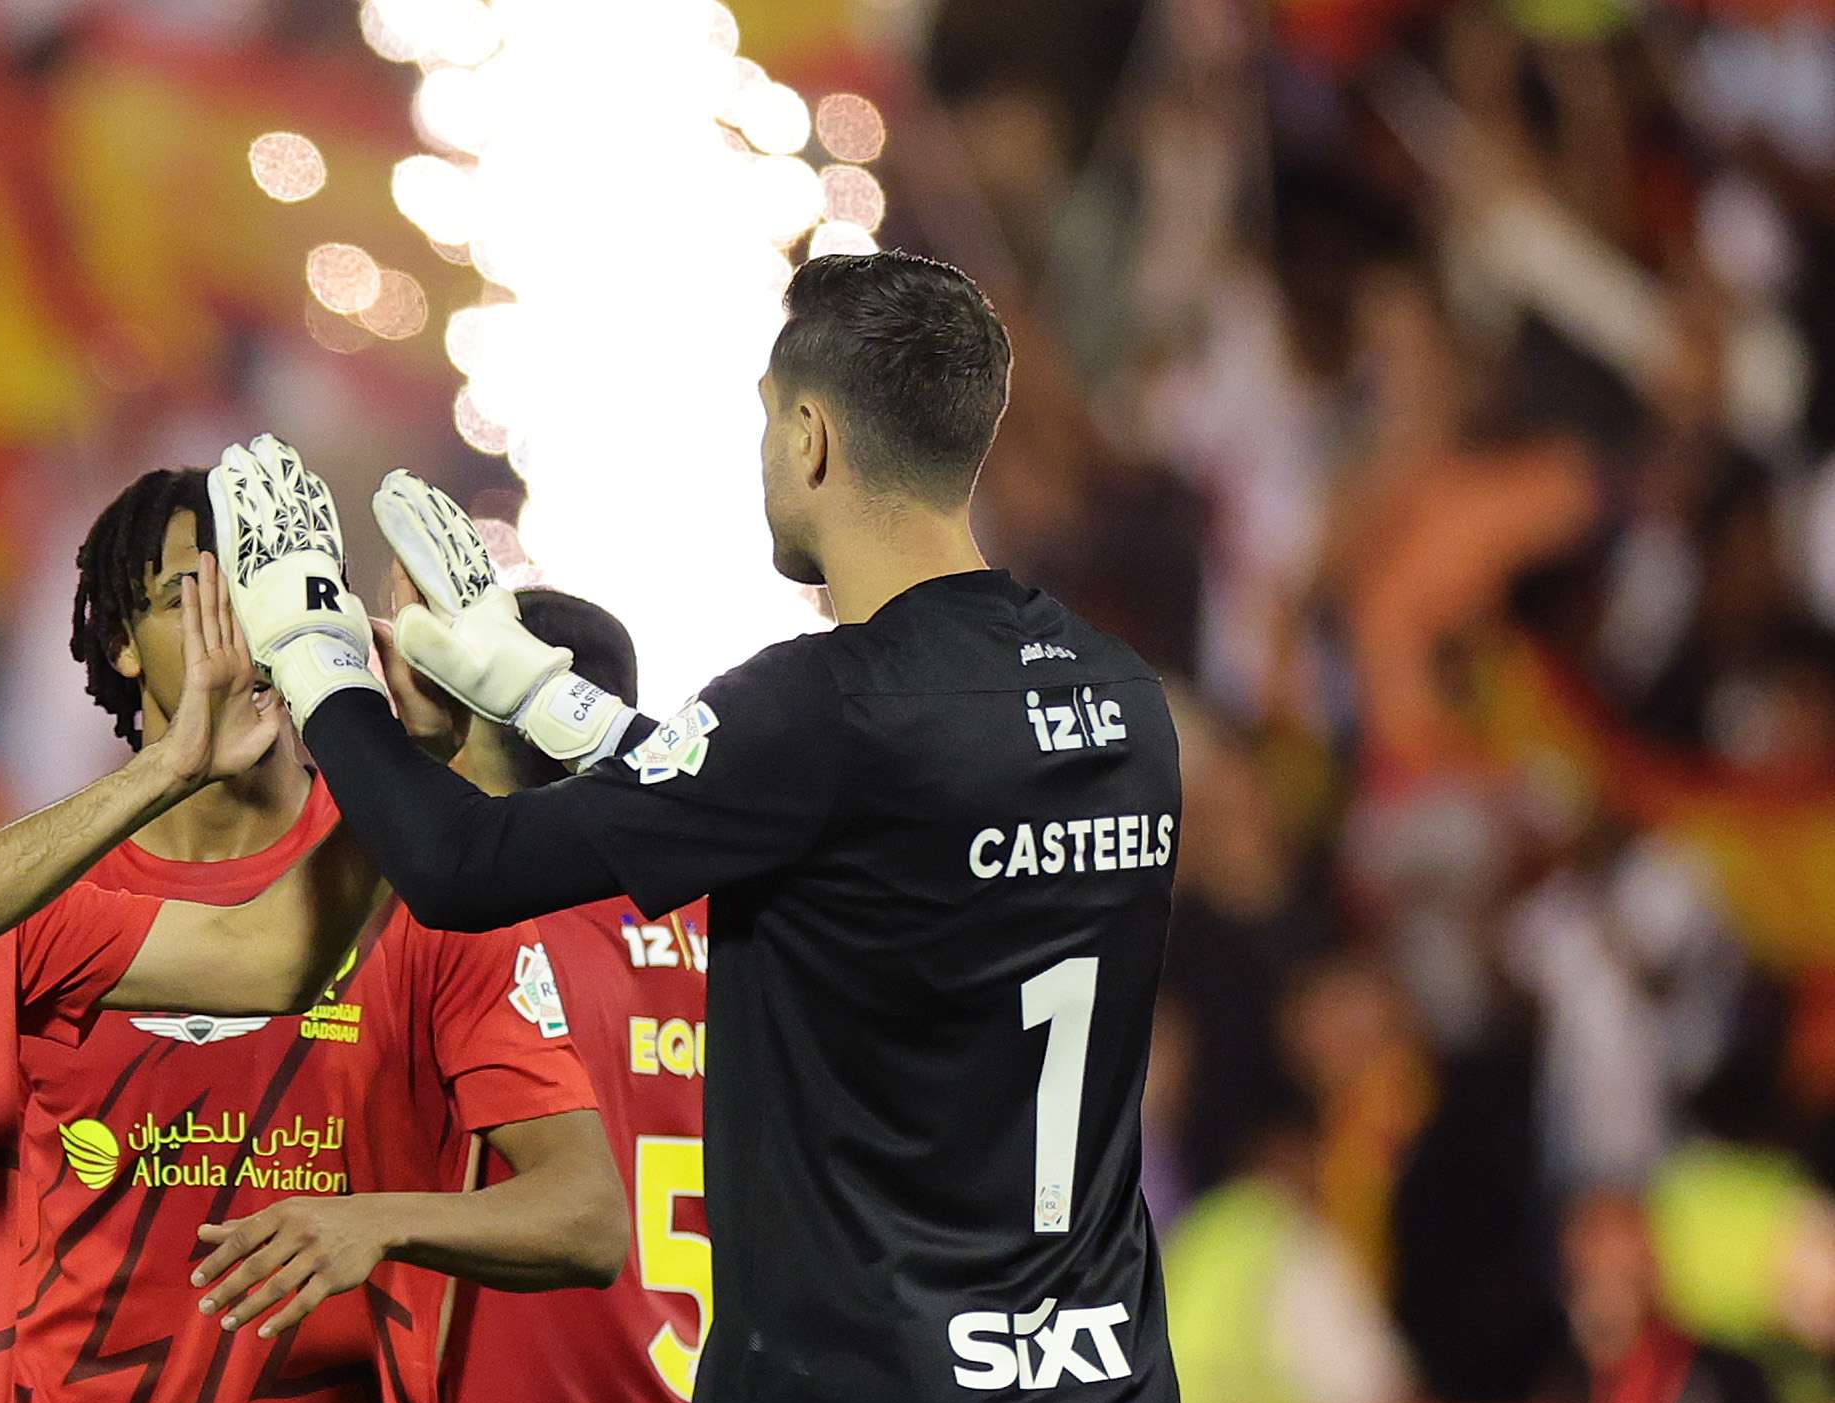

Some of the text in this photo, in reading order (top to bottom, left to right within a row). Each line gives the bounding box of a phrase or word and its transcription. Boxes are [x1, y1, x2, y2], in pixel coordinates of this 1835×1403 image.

[306, 576, 344, 614] R
[968, 814, 1174, 879] CASTEELS
[300, 1020, 360, 1044] QADSIAH
[1019, 957, 1100, 1233] 1
[127, 1111, 246, 1154] للطيران
[132, 1155, 348, 1193] Aloula Aviation
[634, 1135, 713, 1403] 5
[947, 1297, 1135, 1391] SIXT
